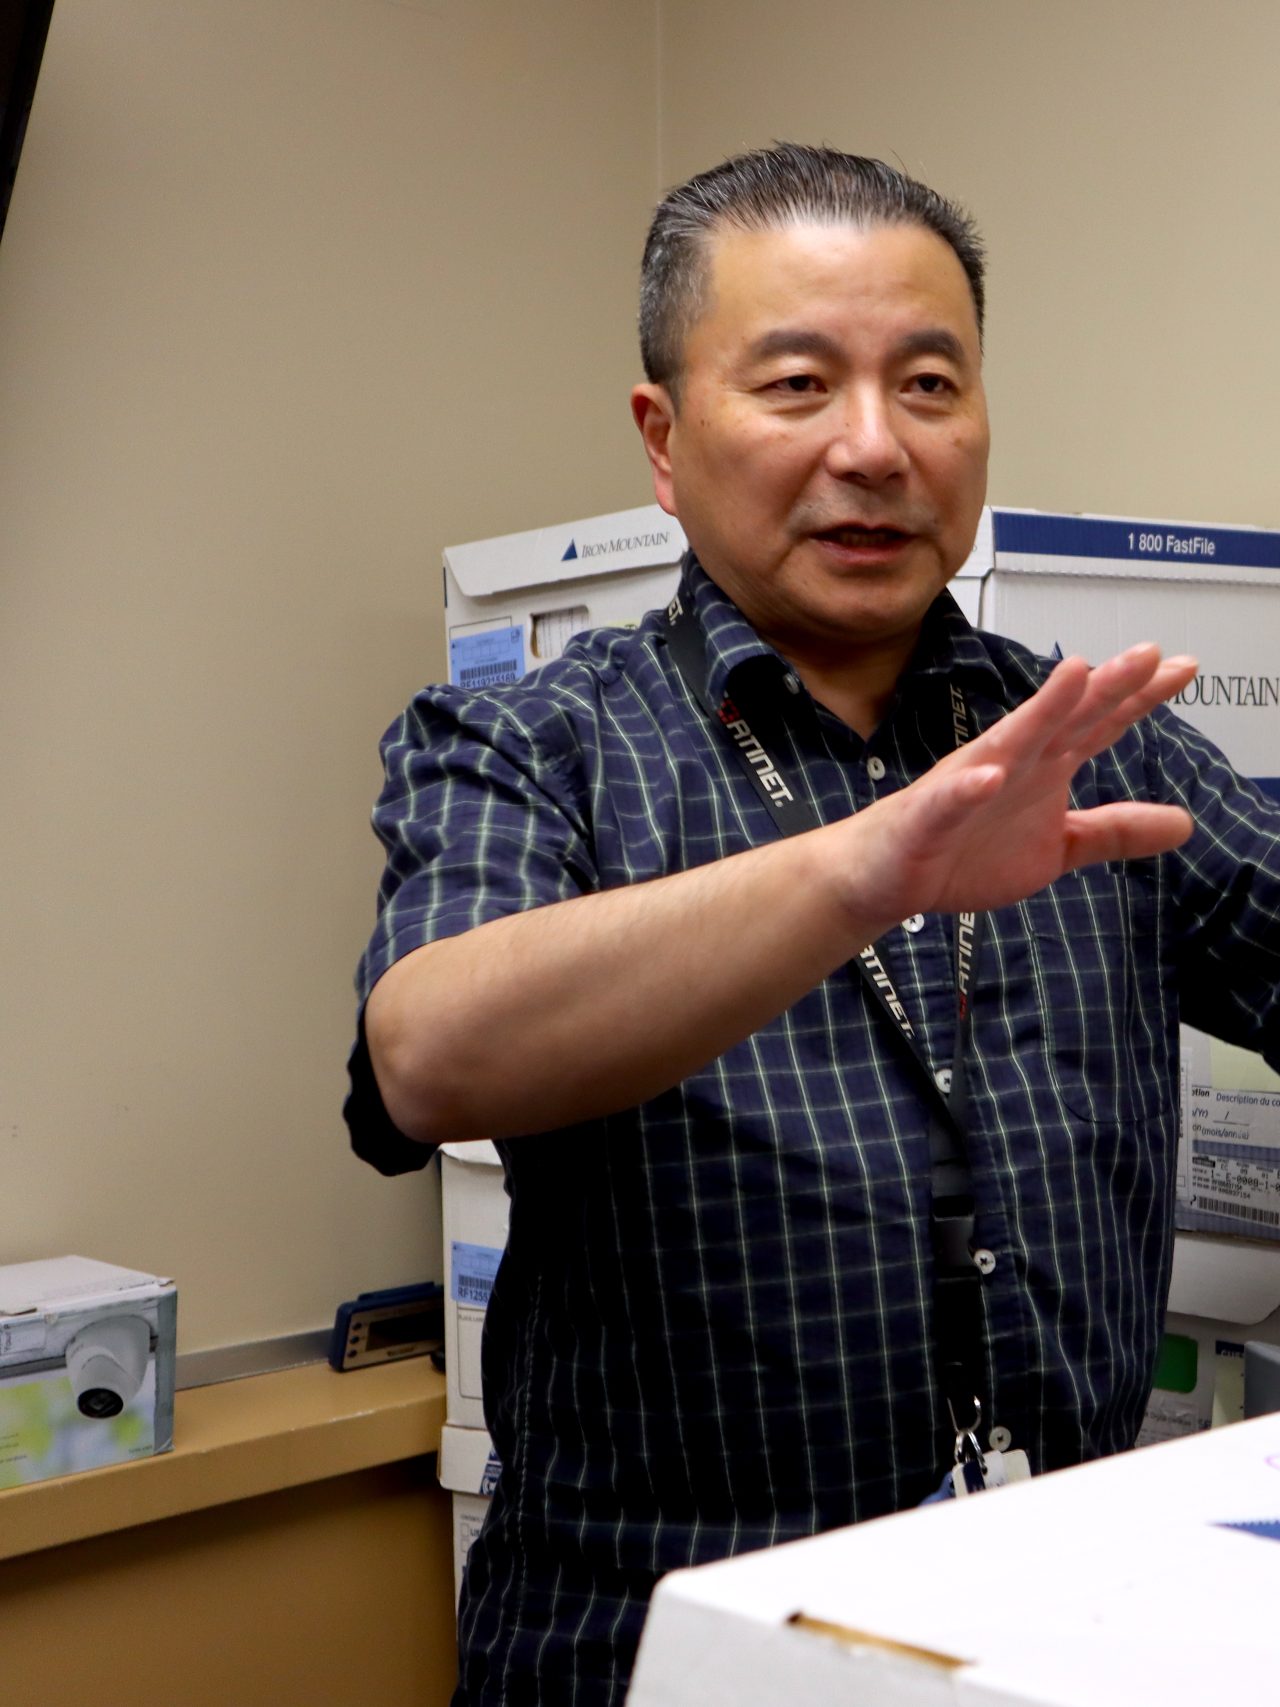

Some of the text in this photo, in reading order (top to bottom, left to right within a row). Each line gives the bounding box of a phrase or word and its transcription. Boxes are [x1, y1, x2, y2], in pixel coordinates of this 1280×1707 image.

[581, 532, 669, 558] IRON MOUNTAIN
[1128, 532, 1215, 555] 1 800 FastFile
[1216, 1093, 1259, 1106] Description
